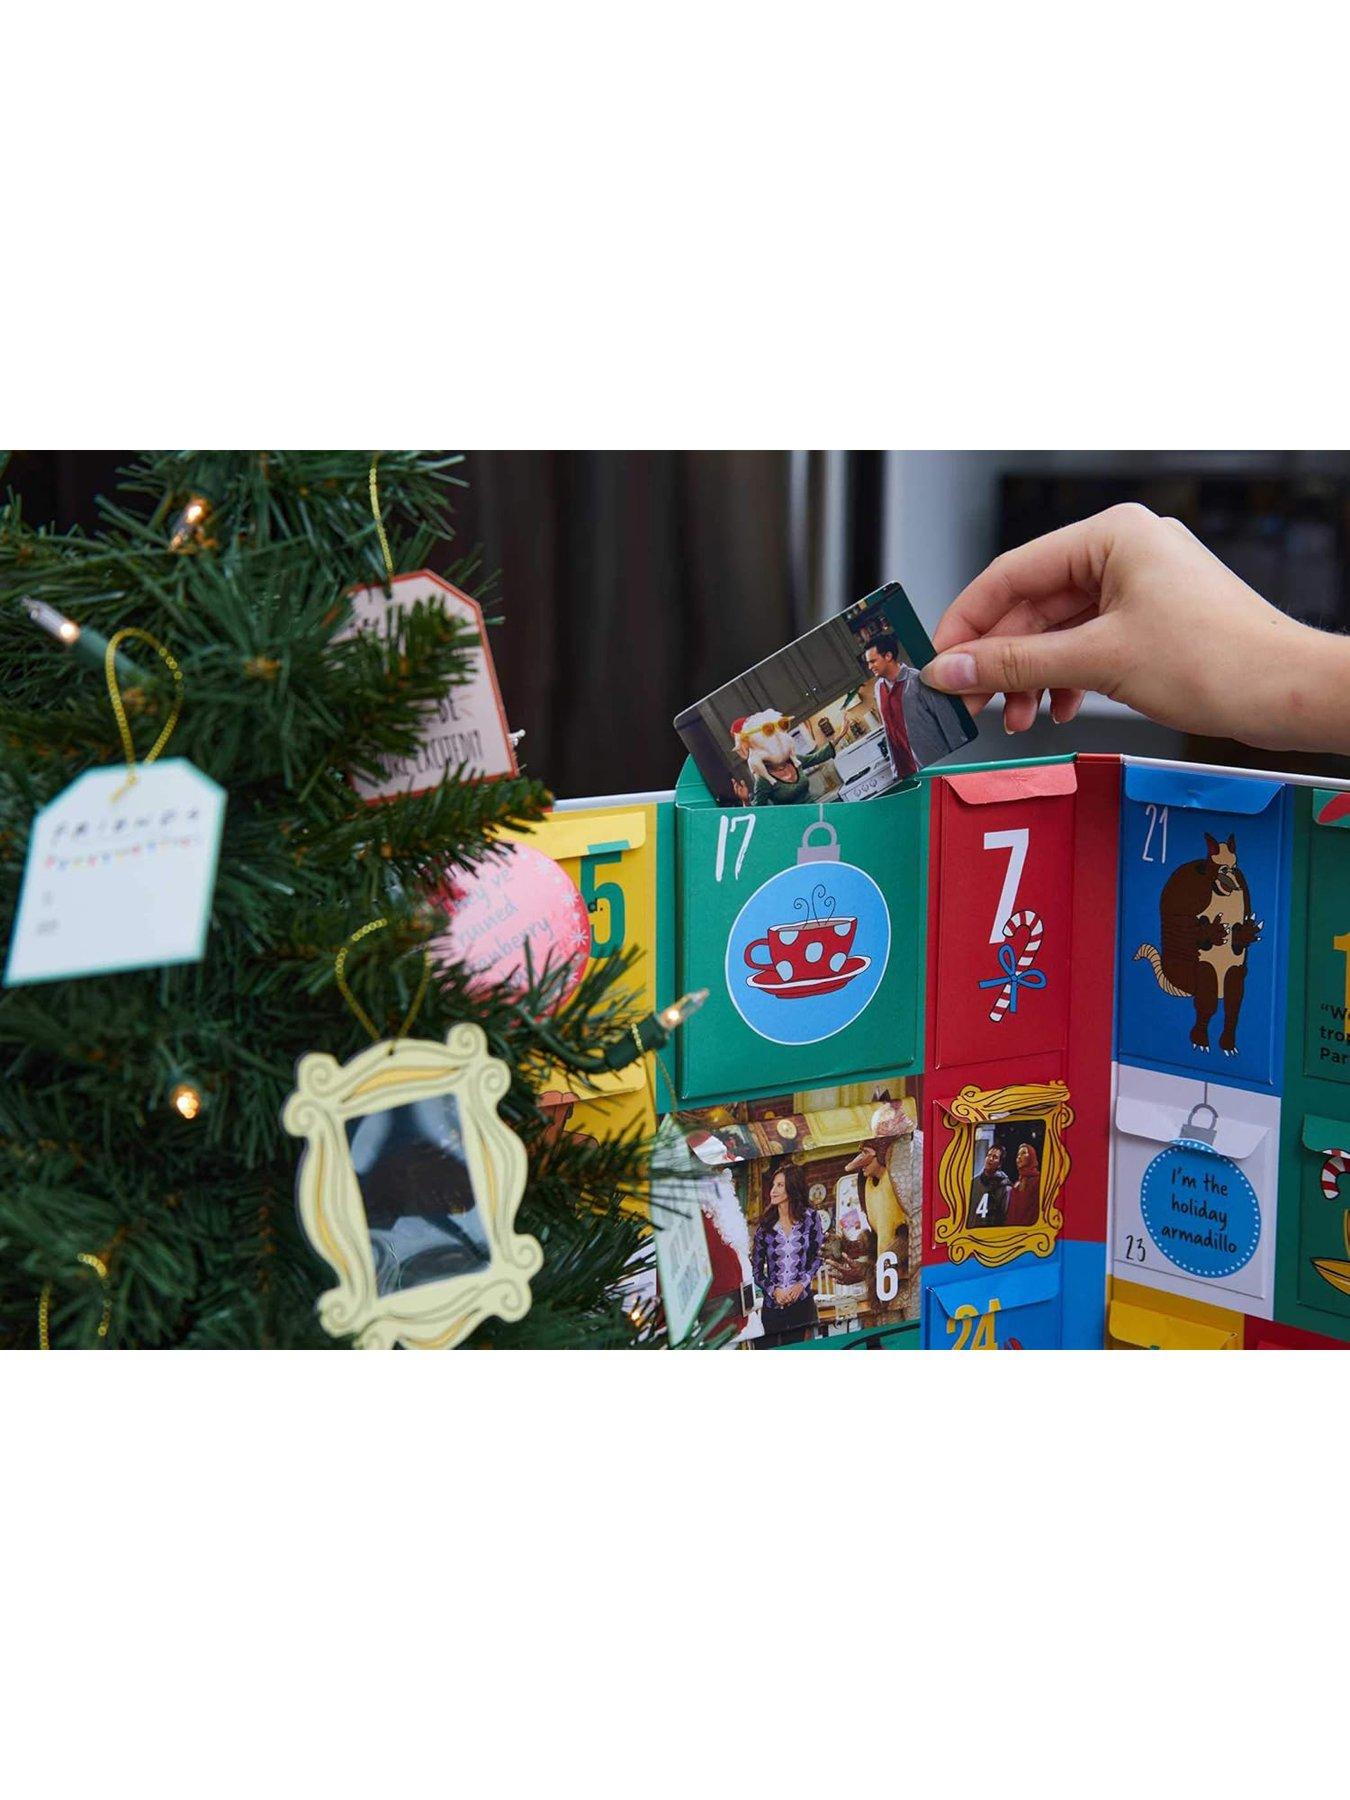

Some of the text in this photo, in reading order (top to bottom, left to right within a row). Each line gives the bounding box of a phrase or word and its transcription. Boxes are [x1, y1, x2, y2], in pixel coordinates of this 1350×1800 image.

[715, 814, 756, 882] 17
[1141, 804, 1169, 864] 21
[580, 839, 630, 958] 5
[983, 828, 1029, 944] 7
[975, 1193, 989, 1218] 4
[1203, 1172, 1229, 1197] the
[1171, 1194, 1228, 1232] holiday
[1126, 1234, 1147, 1262] 23
[1161, 1224, 1238, 1254] armadillo
[876, 1251, 899, 1302] 6
[946, 1298, 1001, 1350] 24
